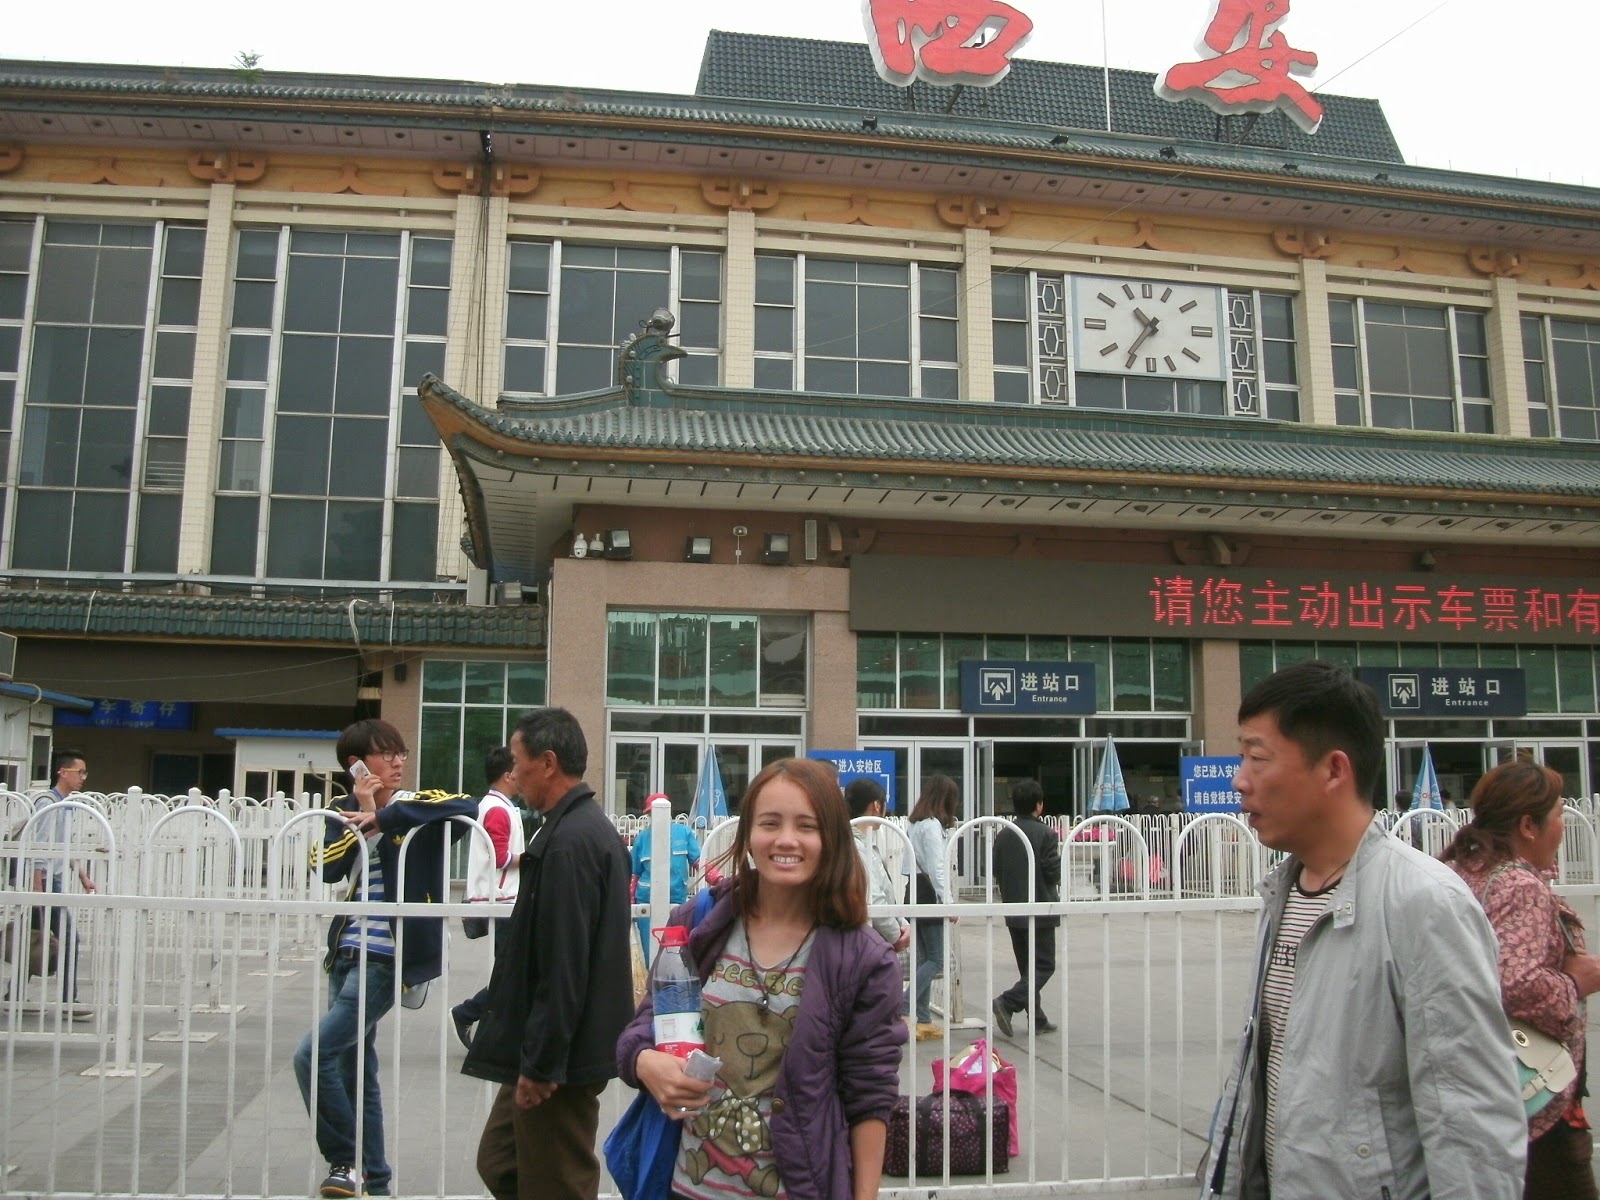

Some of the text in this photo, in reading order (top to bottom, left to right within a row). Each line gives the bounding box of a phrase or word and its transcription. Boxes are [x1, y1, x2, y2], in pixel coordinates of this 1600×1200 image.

[1149, 575, 1600, 634] 请您主动出示车票和有
[1020, 672, 1079, 692] 进站口
[1431, 677, 1500, 696] 进站口
[1032, 695, 1068, 703] Entrance
[1445, 698, 1489, 706] Entrance
